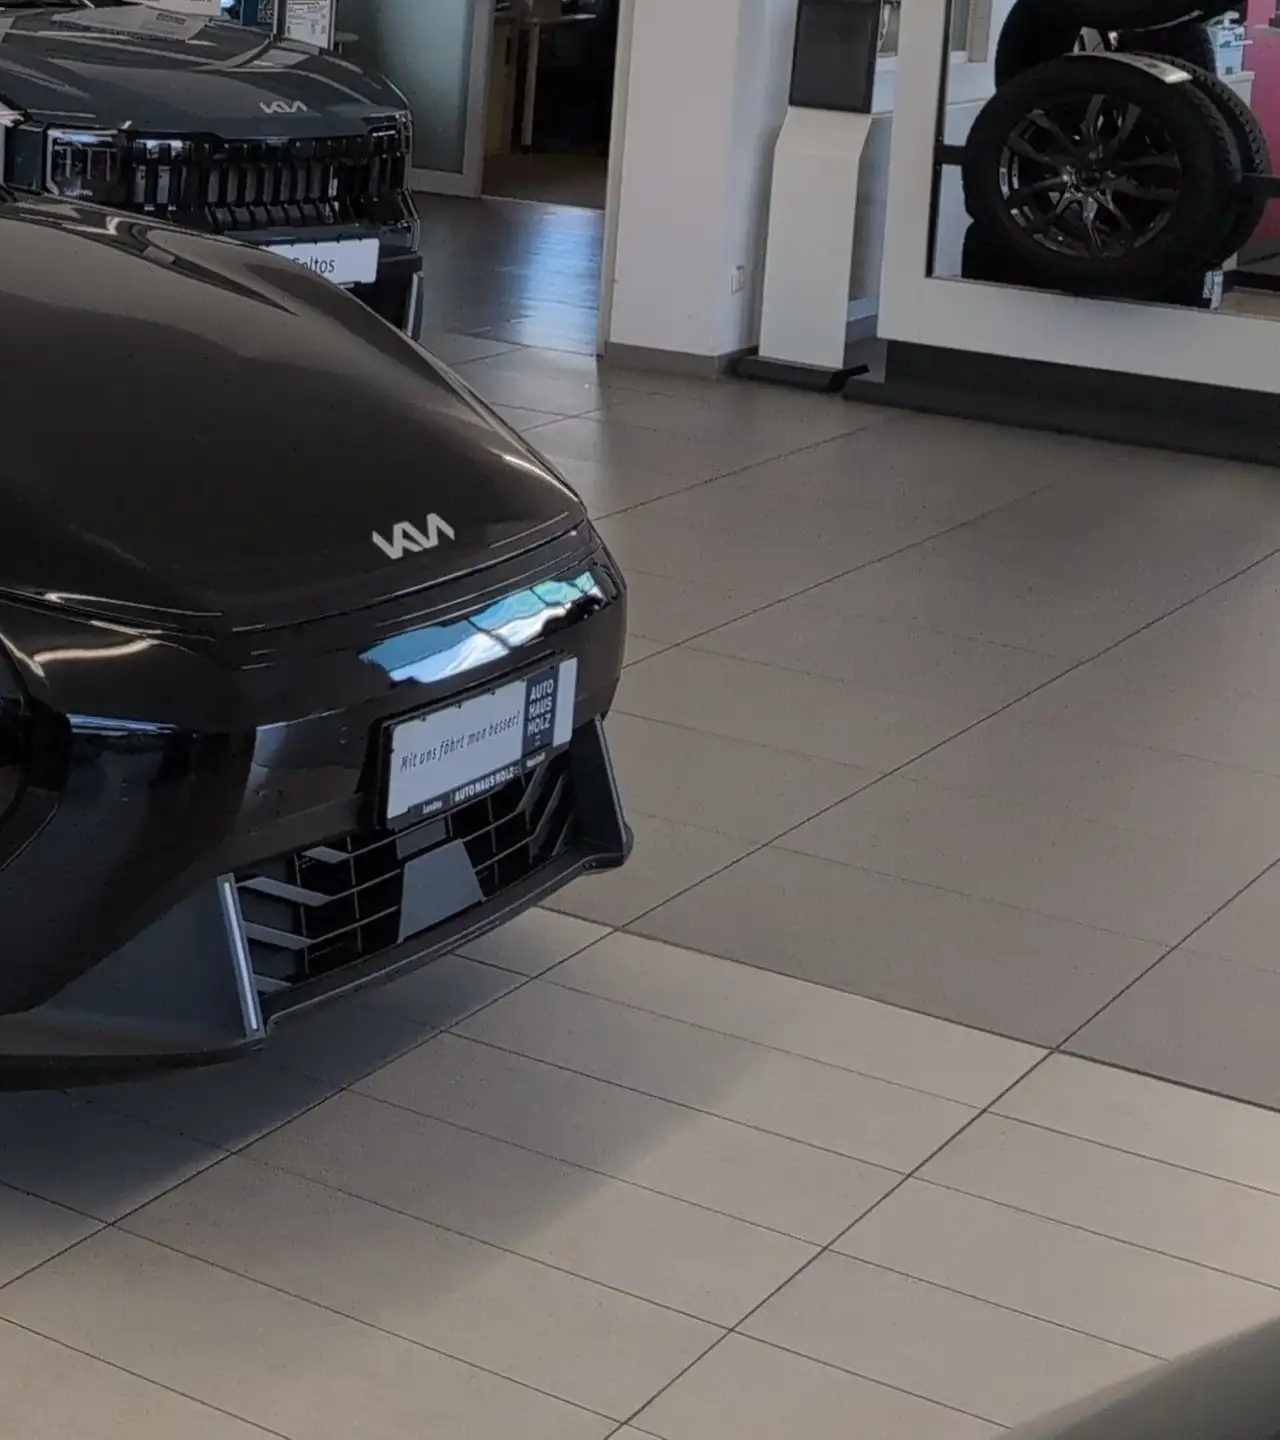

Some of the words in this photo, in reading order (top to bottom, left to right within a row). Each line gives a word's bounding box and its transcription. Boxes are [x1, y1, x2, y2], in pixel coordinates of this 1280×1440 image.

[371, 513, 456, 560] KIA
[529, 678, 554, 702] AUTO
[528, 696, 553, 720] HAUS
[527, 714, 551, 737] HOLZ
[400, 753, 417, 773] Mit
[419, 748, 437, 766] uns
[466, 729, 487, 748] man
[488, 710, 522, 737] besser!
